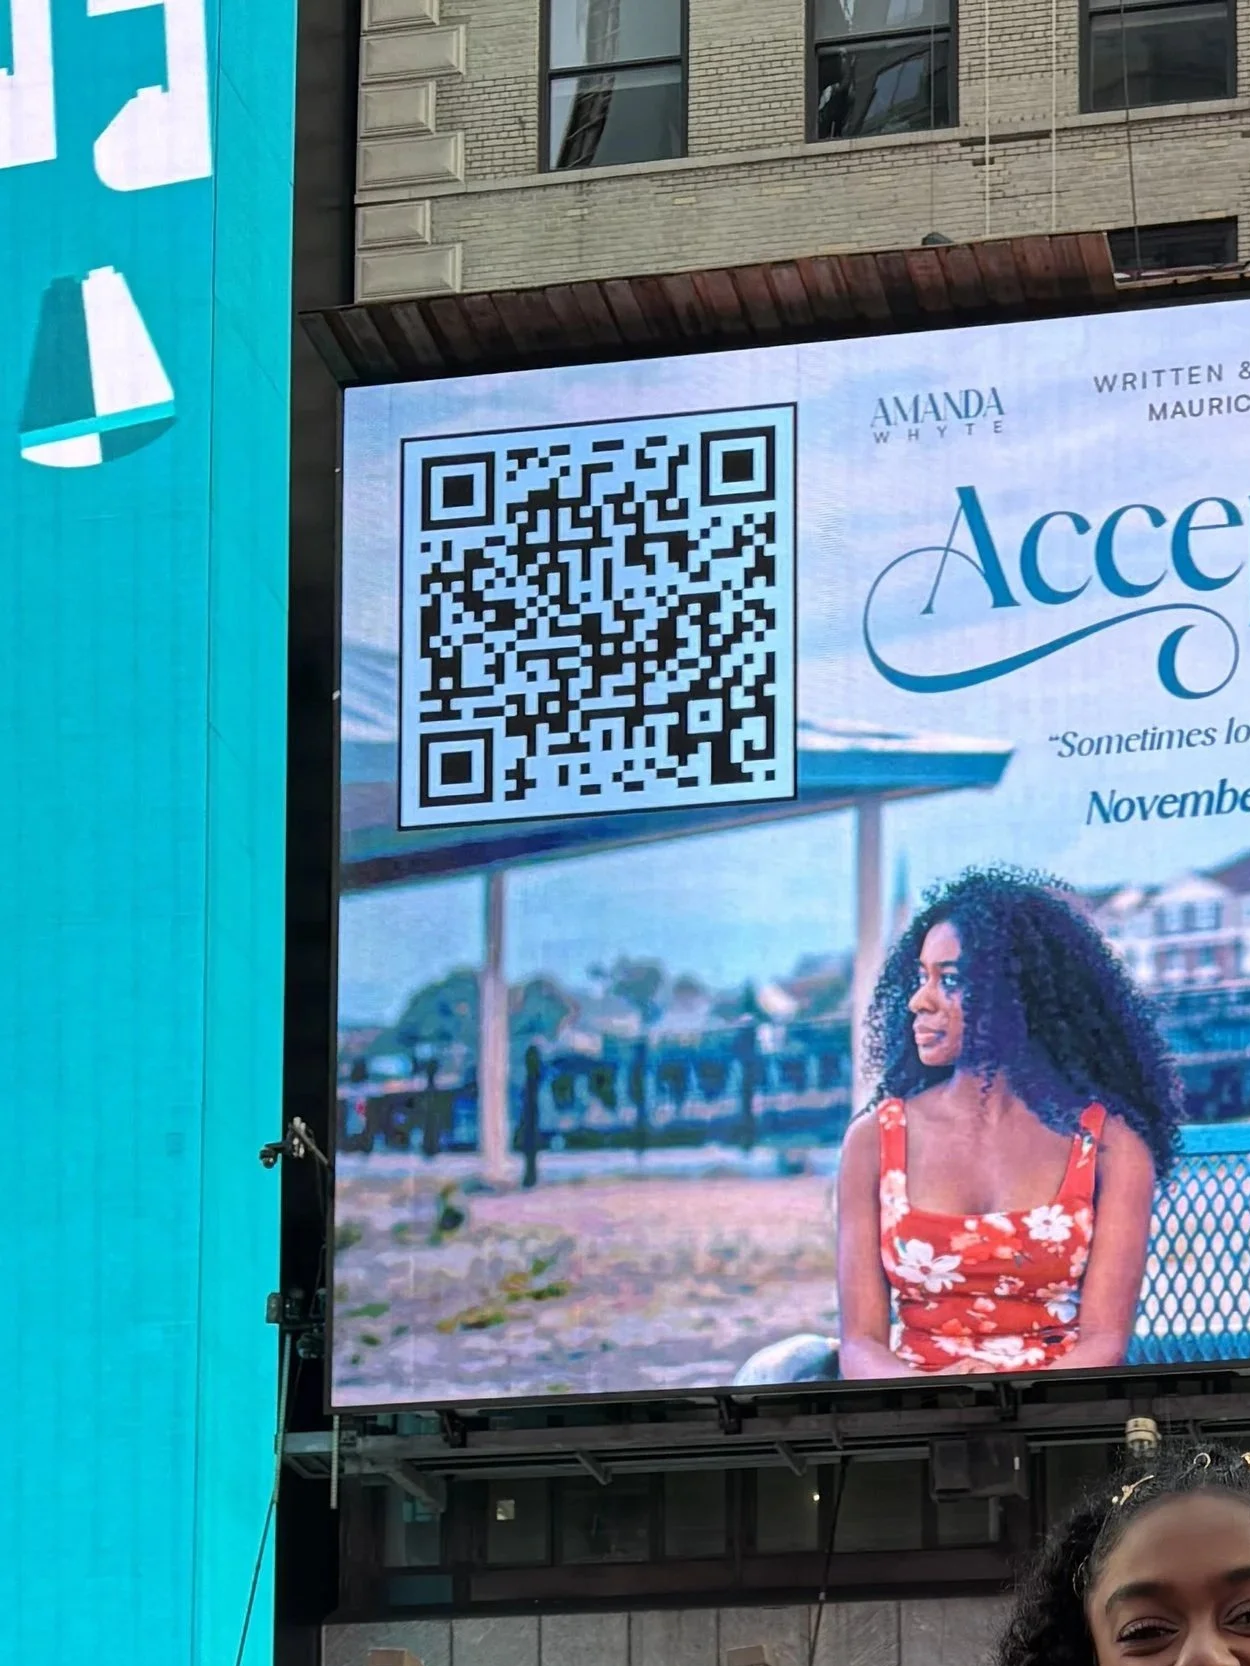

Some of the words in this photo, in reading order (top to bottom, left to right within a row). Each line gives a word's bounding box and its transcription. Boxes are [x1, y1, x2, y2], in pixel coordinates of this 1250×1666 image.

[1093, 363, 1224, 393] WRITTEN
[870, 386, 1006, 428] AMANDA
[873, 420, 1004, 444] WHYTE
